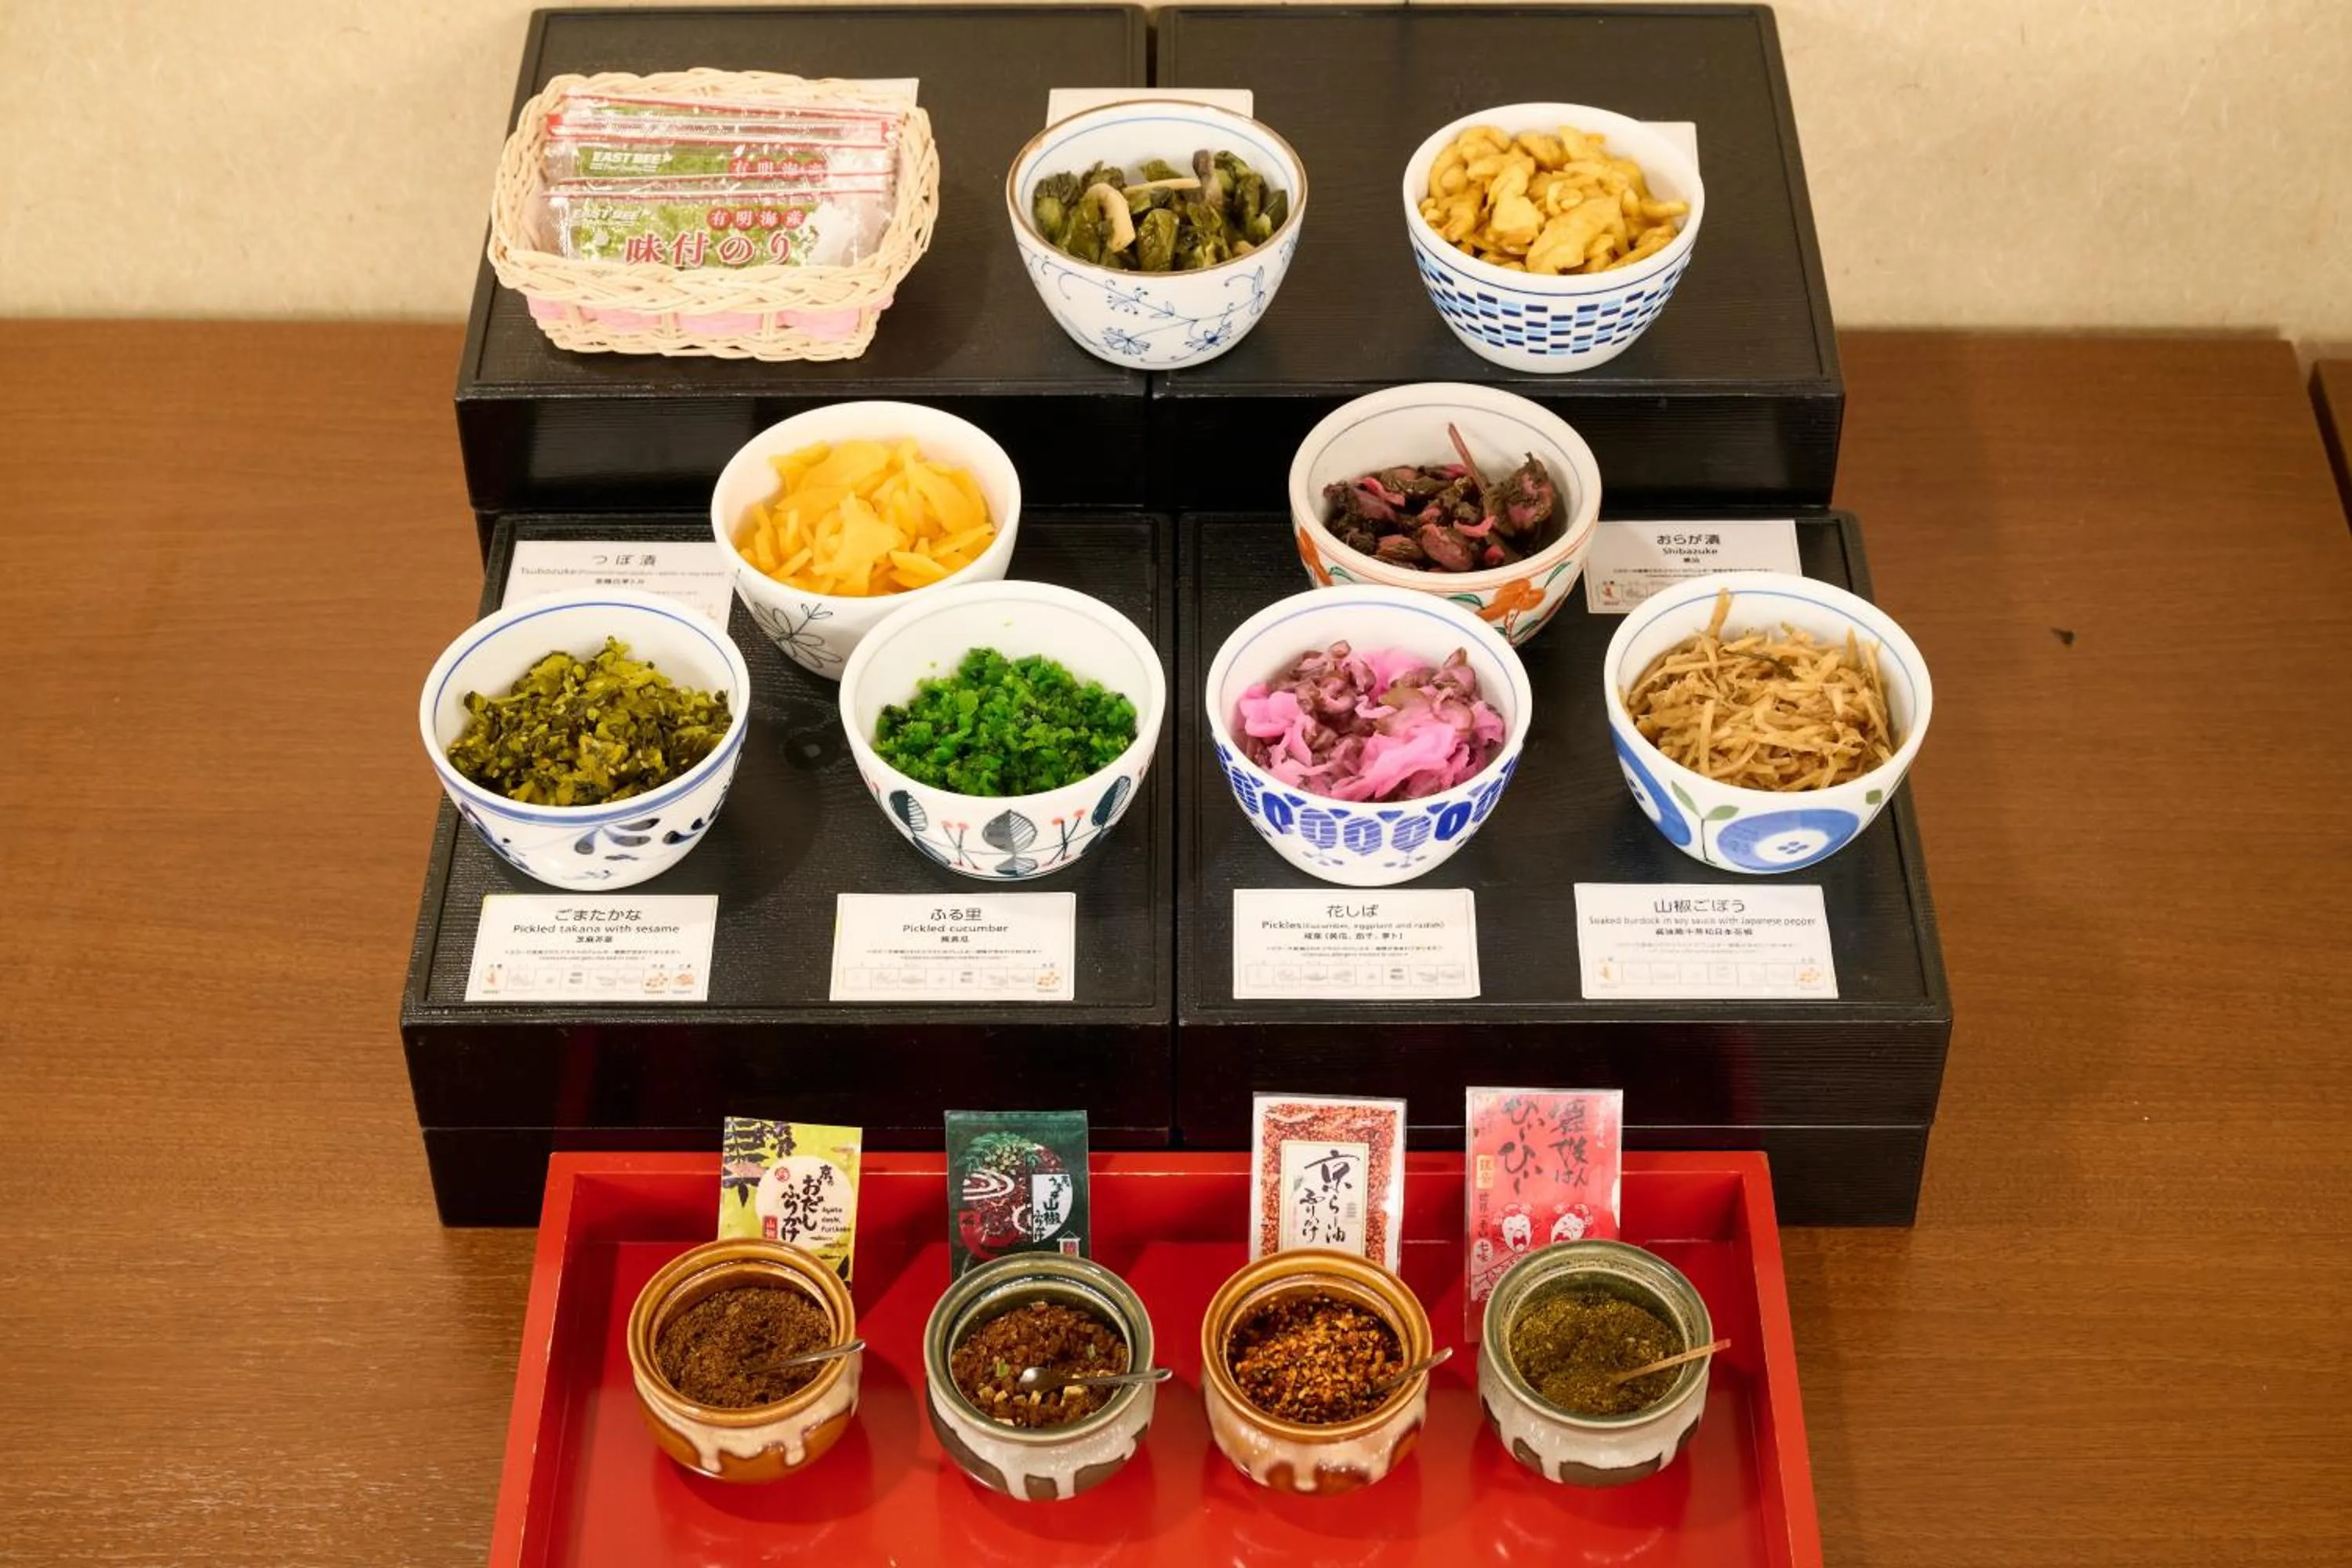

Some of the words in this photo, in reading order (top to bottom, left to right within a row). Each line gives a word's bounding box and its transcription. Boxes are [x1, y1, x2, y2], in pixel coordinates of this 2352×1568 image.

[710, 209, 804, 227] 有明海産
[626, 232, 792, 266] 味付のり
[593, 554, 656, 565] つぼ漬
[1327, 904, 1379, 918] 花しば
[1653, 899, 1745, 913] 山椒ごぼう
[555, 909, 642, 921] ごまたかな
[931, 908, 982, 921] ふる里
[1719, 916, 1738, 925] with
[513, 924, 556, 934] Pickled
[560, 924, 600, 934] takana
[605, 924, 631, 934] with
[902, 924, 945, 933] Pickled
[949, 924, 1008, 933] cucumber
[800, 1174, 824, 1231] おだし
